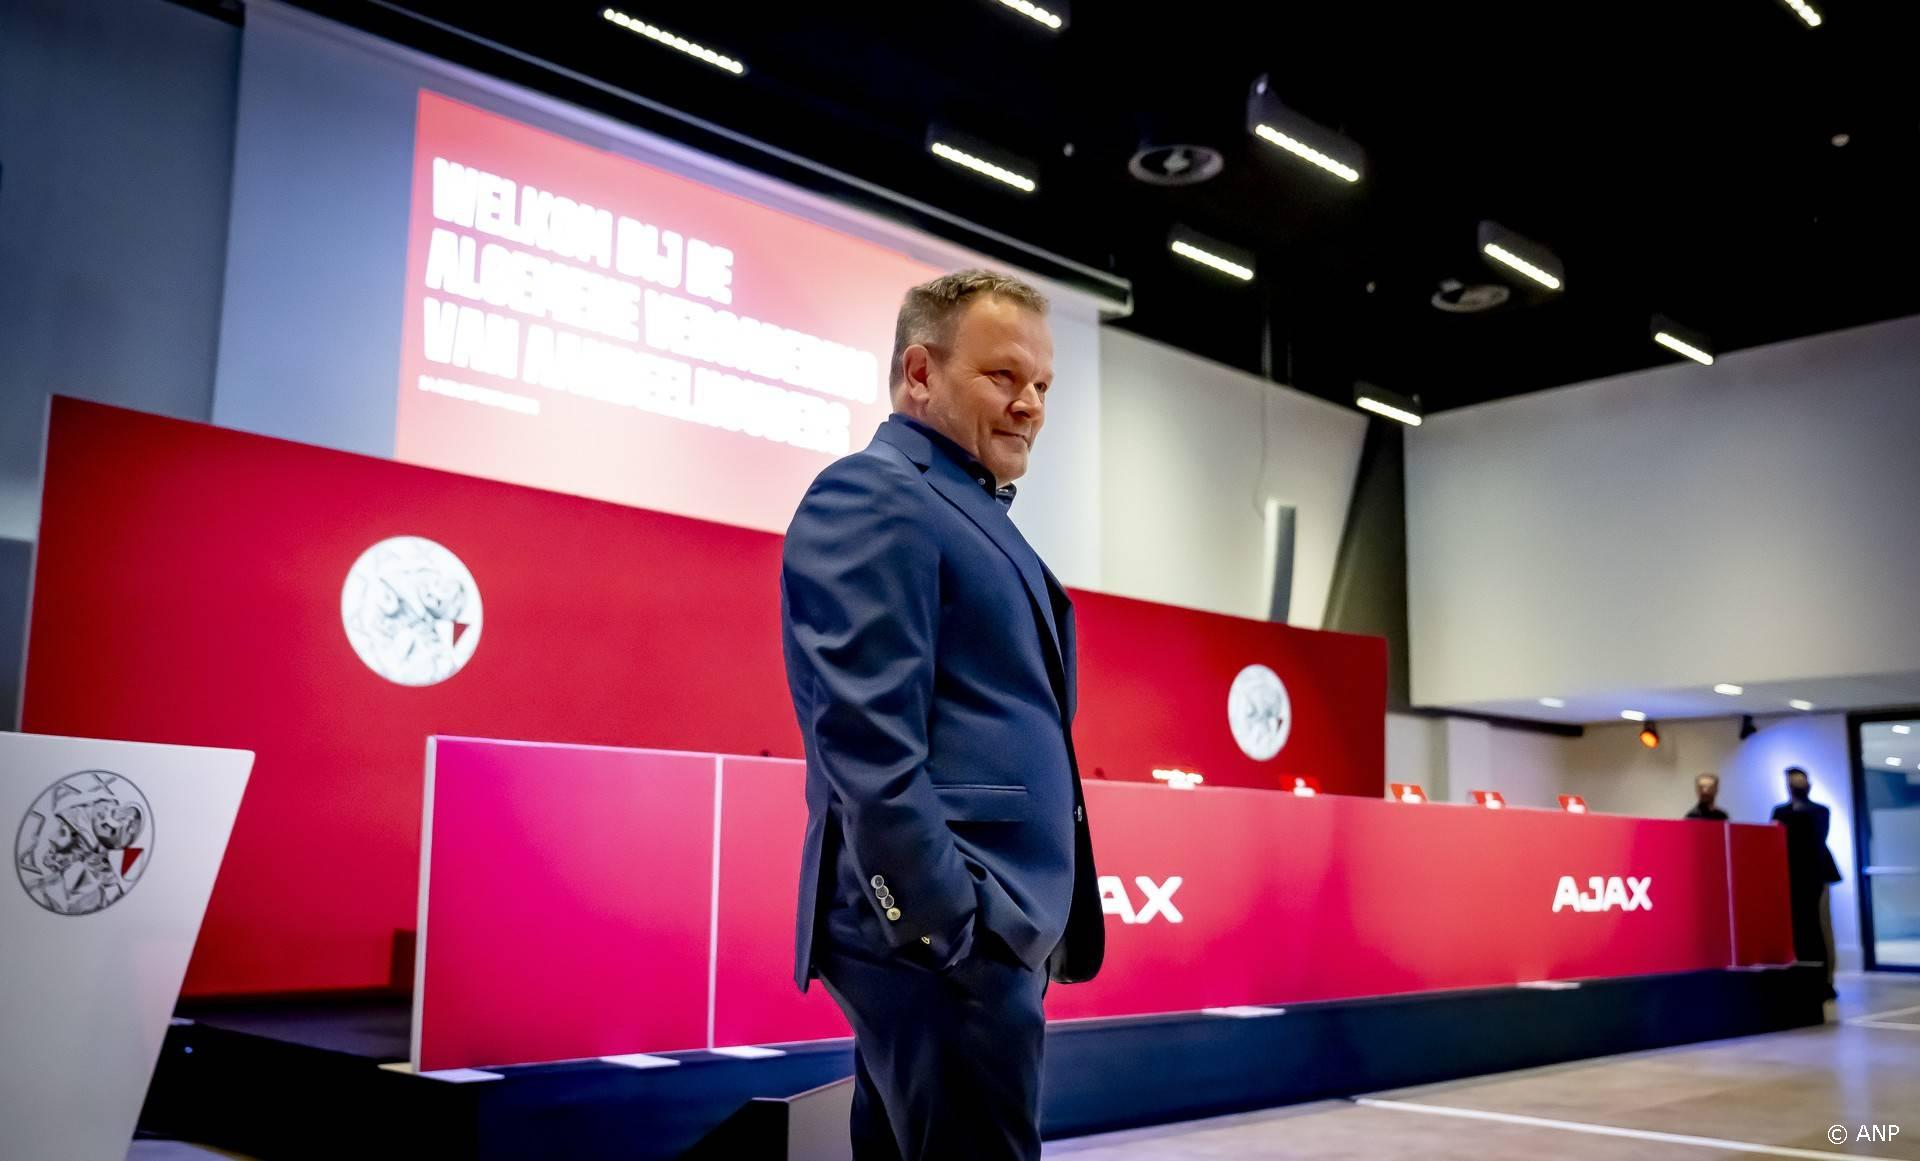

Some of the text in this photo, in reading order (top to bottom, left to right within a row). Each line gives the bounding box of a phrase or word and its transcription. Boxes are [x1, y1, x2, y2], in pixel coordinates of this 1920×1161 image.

[432, 157, 613, 269] WELKOM
[423, 296, 519, 379] VAN
[1097, 875, 1184, 925] AX
[1551, 875, 1654, 913] AJAX
